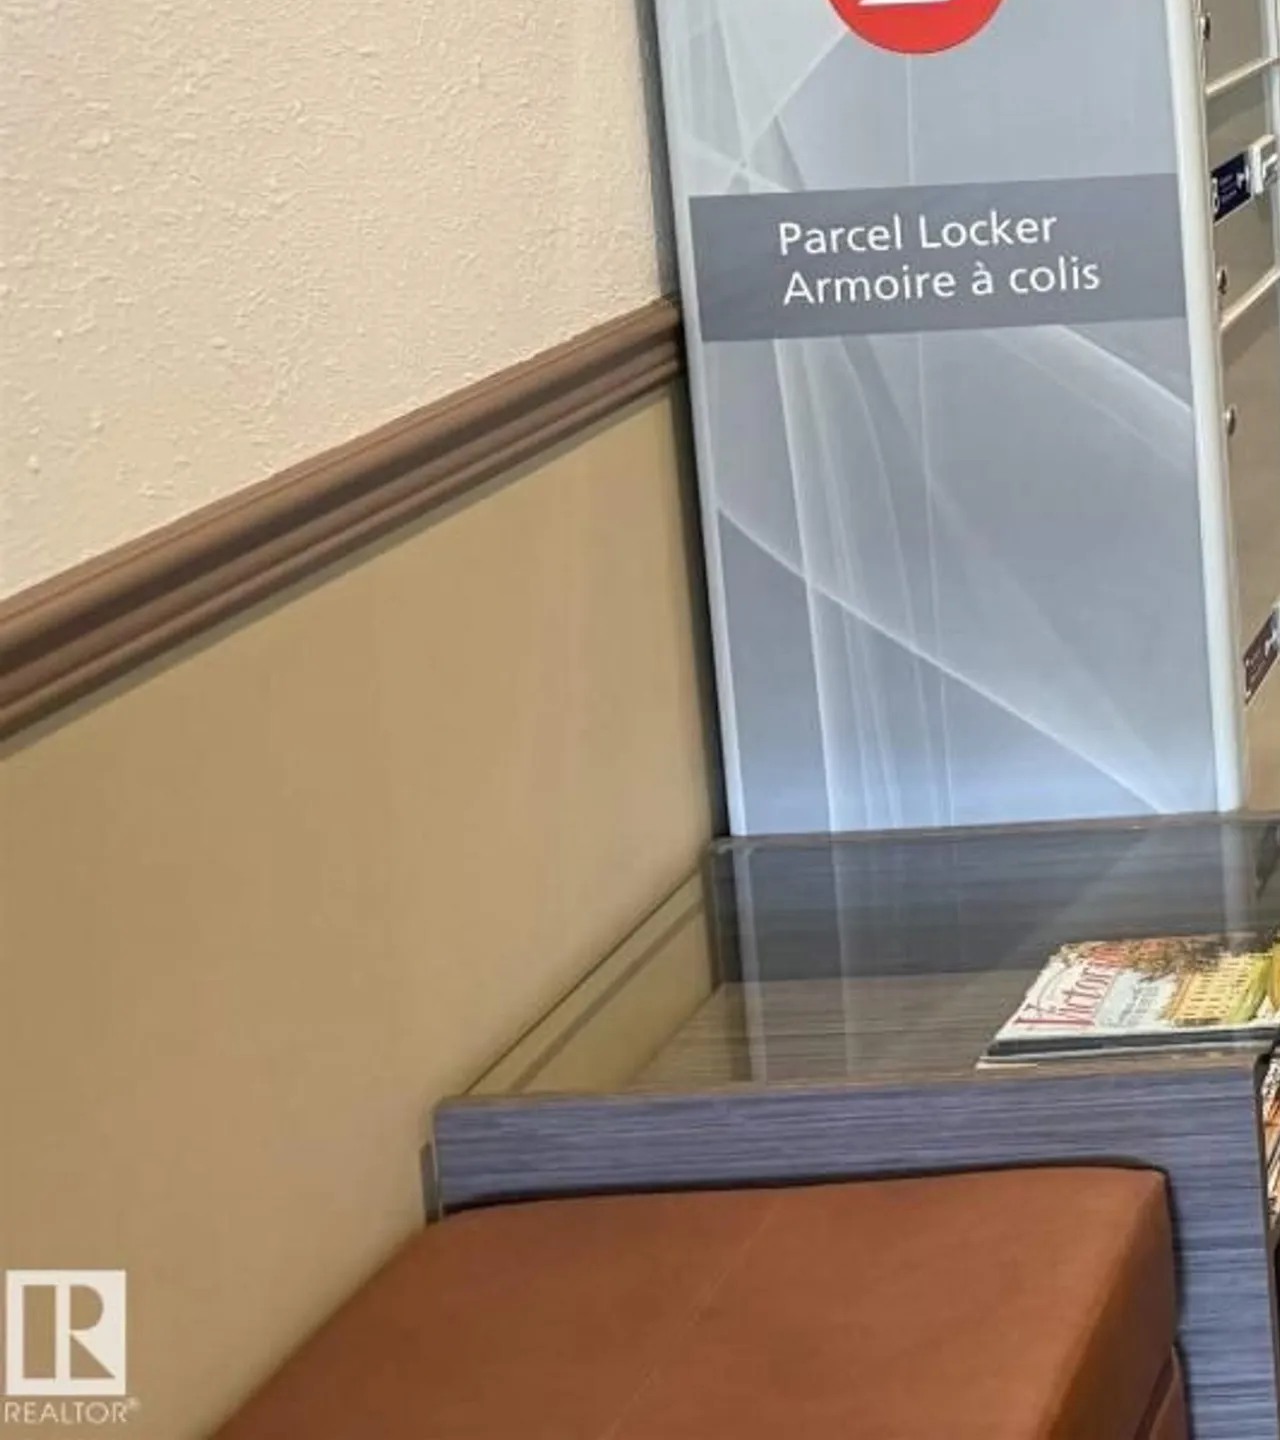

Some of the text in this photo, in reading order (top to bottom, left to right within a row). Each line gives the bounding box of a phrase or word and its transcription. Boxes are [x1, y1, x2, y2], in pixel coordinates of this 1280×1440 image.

[778, 208, 1058, 256] Parcel Locker
[783, 256, 1101, 306] Armoire à colis
